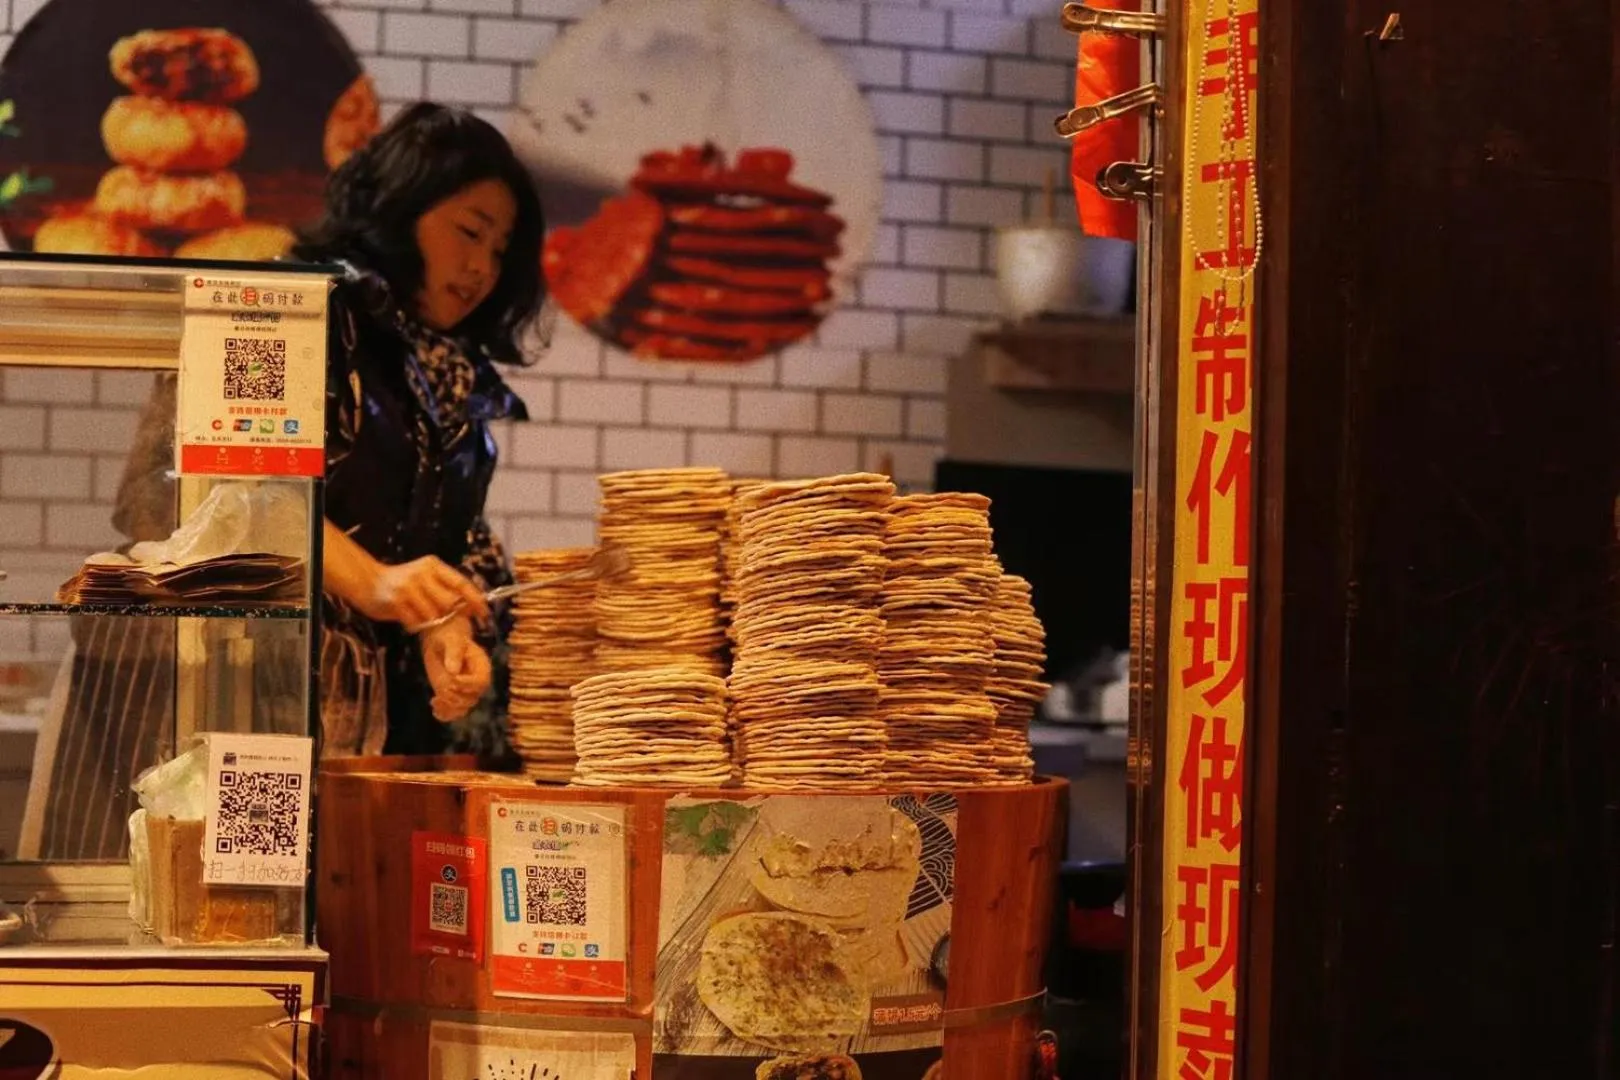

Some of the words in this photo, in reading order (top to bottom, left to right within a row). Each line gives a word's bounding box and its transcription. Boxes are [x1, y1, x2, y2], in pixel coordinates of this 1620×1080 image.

[212, 287, 304, 306] 在此扫码付款
[514, 818, 601, 836] 在此扫码付款
[425, 841, 476, 859] 扫码领红包
